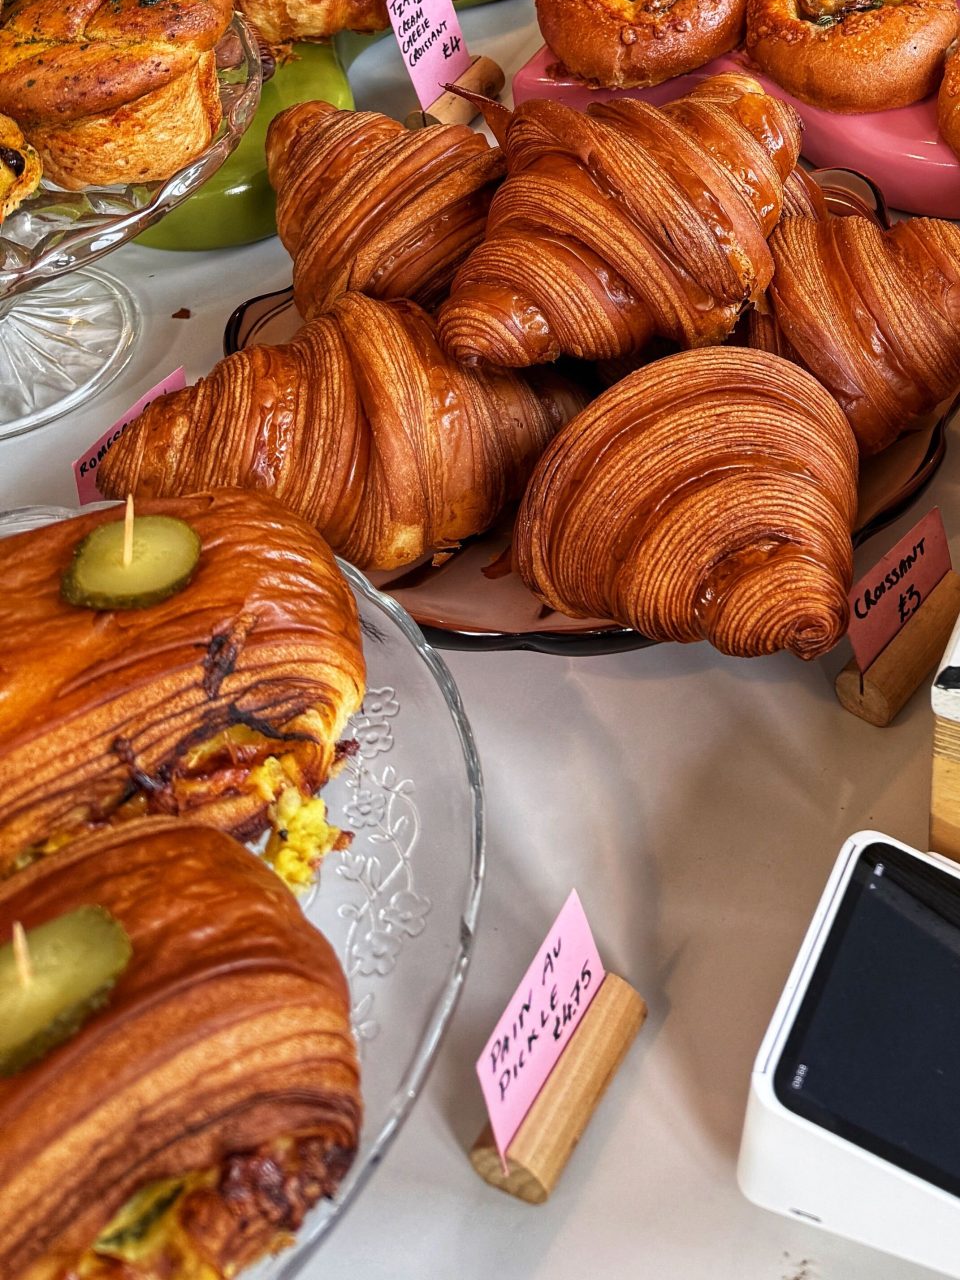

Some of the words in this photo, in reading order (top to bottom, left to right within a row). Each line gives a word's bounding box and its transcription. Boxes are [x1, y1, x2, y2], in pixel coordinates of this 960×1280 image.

[398, 7, 424, 38] CREAM
[402, 18, 430, 54] CHEESE
[409, 21, 448, 67] CROISSANT
[442, 36, 461, 60] £4
[854, 537, 925, 619] CROISSANT
[490, 988, 532, 1074] PAIN
[542, 937, 562, 986] AU
[499, 983, 559, 1102] PICKLE
